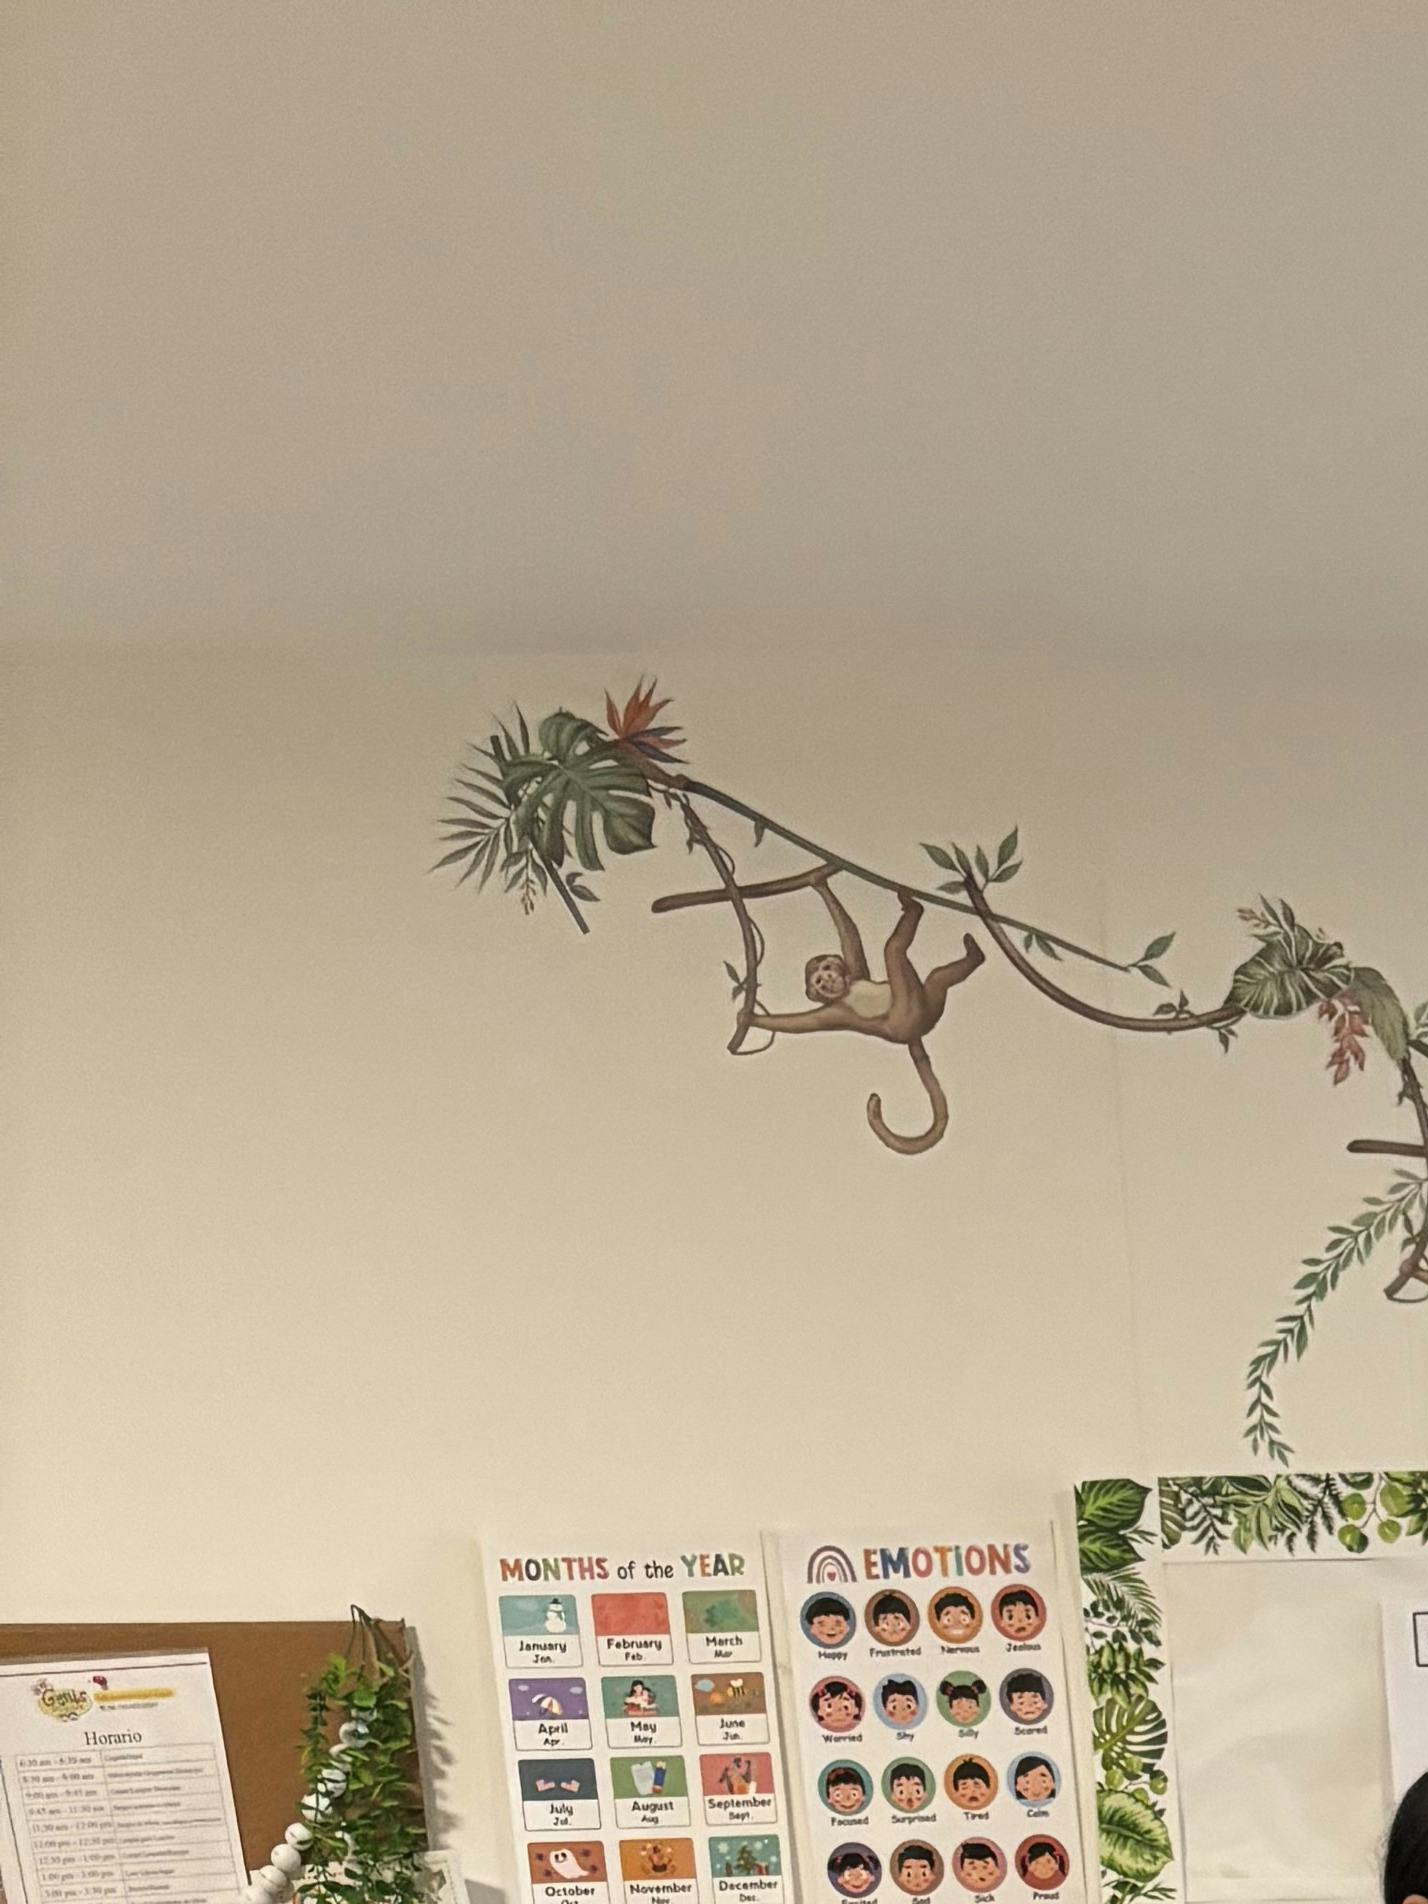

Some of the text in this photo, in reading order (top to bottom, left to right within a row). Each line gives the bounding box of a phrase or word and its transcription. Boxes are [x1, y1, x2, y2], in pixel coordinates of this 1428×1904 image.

[863, 1542, 1031, 1580] EMOTIONS
[500, 1554, 745, 1582] MONTHS of the YEAR
[519, 1640, 566, 1652] January
[607, 1638, 662, 1650] February
[706, 1636, 742, 1647] March
[1006, 1642, 1041, 1652] Jealous
[870, 1646, 922, 1657] Frustrated
[941, 1644, 979, 1654] Nervous
[818, 1650, 848, 1660] Happy
[538, 1722, 568, 1735] April
[631, 1721, 657, 1733] May
[720, 1718, 745, 1729] June
[958, 1728, 979, 1739] Silly
[1014, 1725, 1048, 1735] Scared
[85, 1729, 142, 1746] Horario
[823, 1734, 863, 1743] Worried
[896, 1731, 915, 1742] Shy
[632, 1801, 674, 1813] August
[708, 1797, 771, 1809] September
[549, 1804, 573, 1816] July
[963, 1811, 989, 1820] Tired
[1027, 1809, 1049, 1818] Calm
[831, 1816, 869, 1826] Focused
[891, 1813, 936, 1824] Surprised
[545, 1886, 595, 1896] October
[629, 1882, 692, 1894] November
[718, 1880, 778, 1891] December
[912, 1896, 930, 1904] Sad
[975, 1894, 995, 1903] Sick
[1033, 1891, 1060, 1900] Proud
